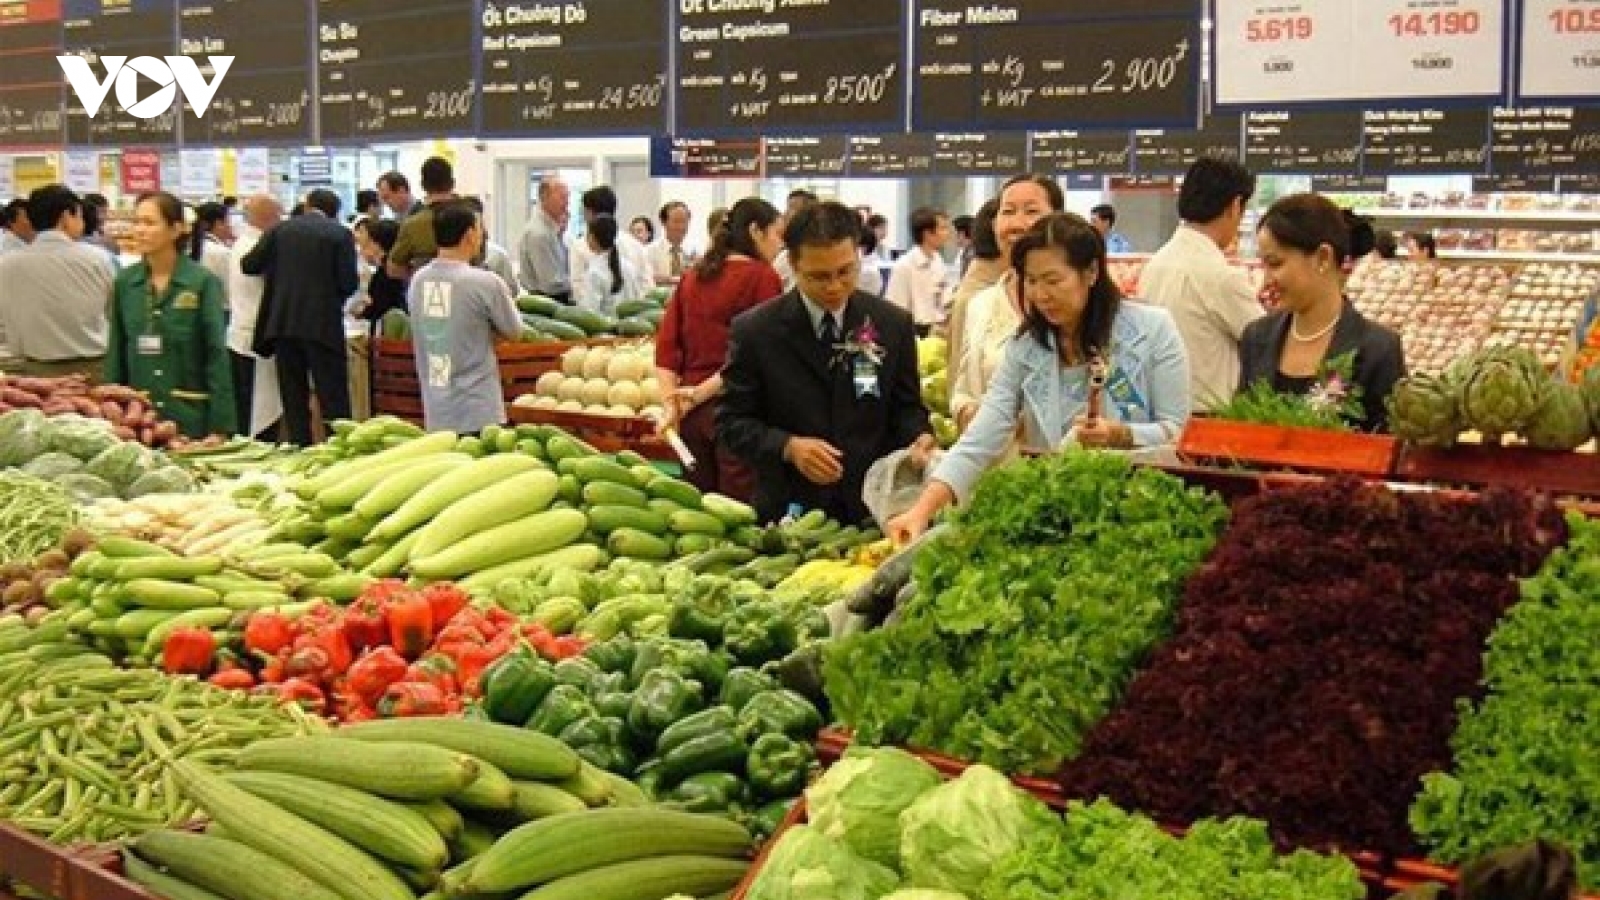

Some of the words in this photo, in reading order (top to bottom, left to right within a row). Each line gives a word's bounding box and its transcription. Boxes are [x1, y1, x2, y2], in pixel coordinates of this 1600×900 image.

[920, 9, 962, 26] Fiber
[965, 5, 1019, 24] Melon
[1388, 11, 1480, 37] 14.190
[722, 20, 790, 42] Capsicum
[1246, 17, 1313, 43] 5.619
[1002, 54, 1025, 87] Kg
[997, 88, 1034, 107] VAT
